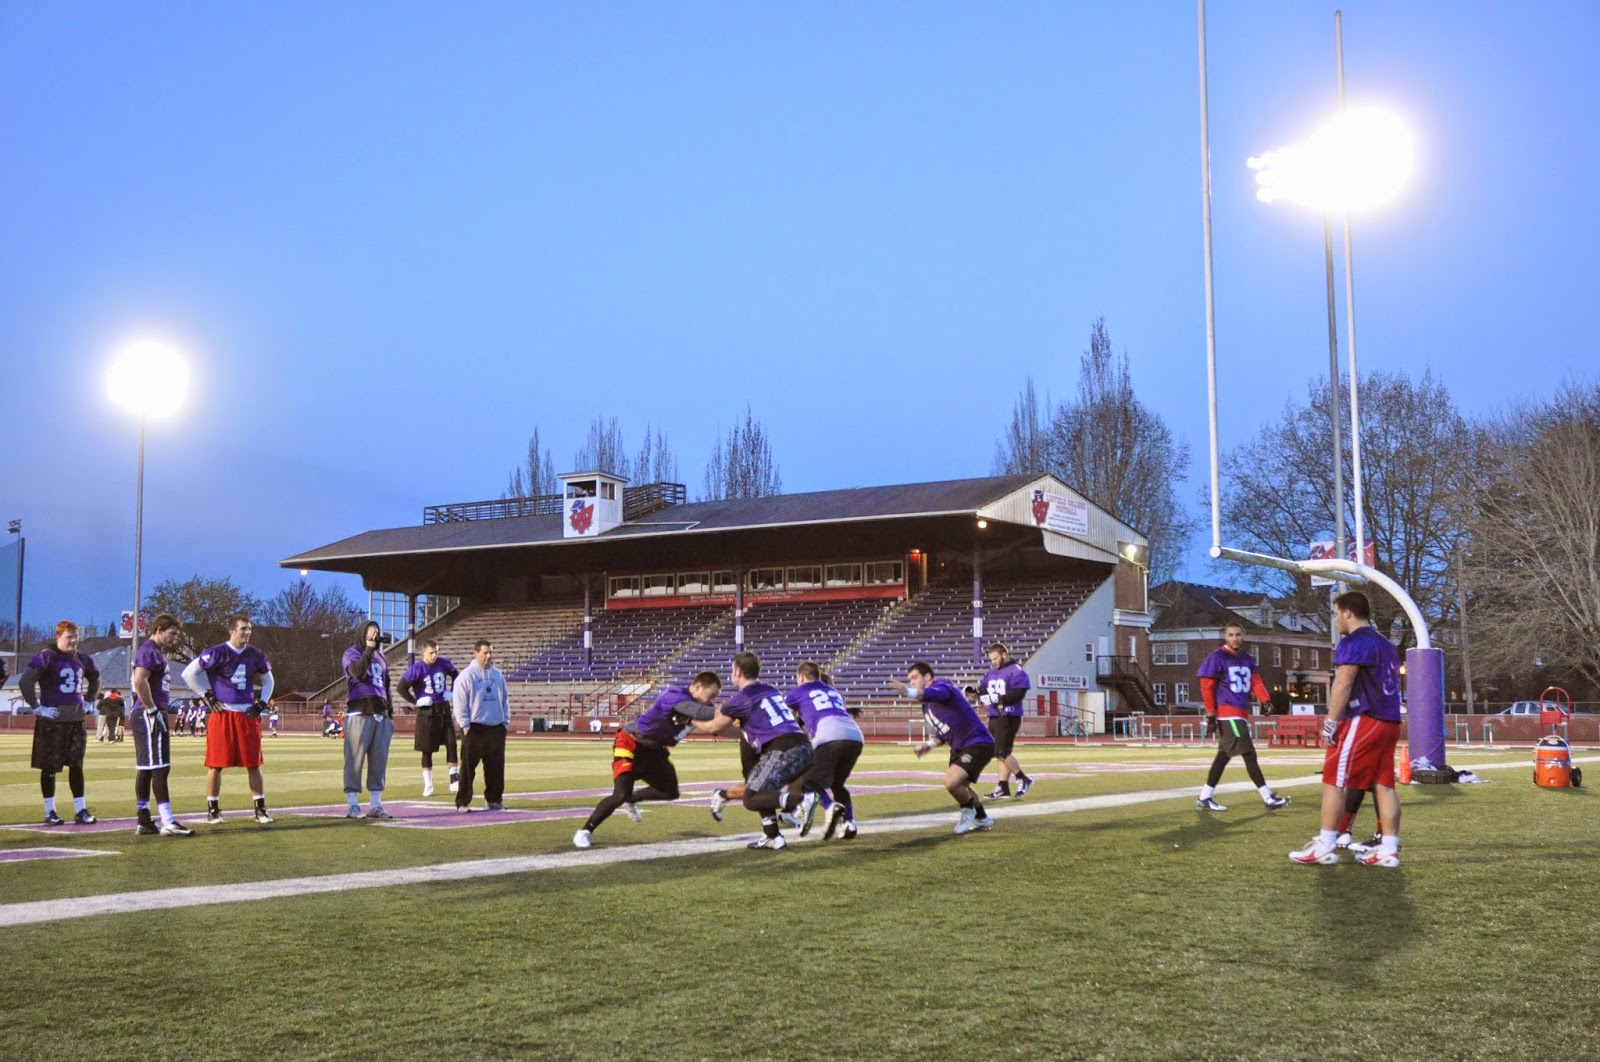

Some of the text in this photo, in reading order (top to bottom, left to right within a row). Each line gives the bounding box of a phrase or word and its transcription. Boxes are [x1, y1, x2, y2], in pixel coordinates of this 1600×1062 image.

[60, 667, 83, 694] 31
[231, 663, 247, 690] 4
[424, 672, 445, 694] 18
[1228, 666, 1252, 693] 53
